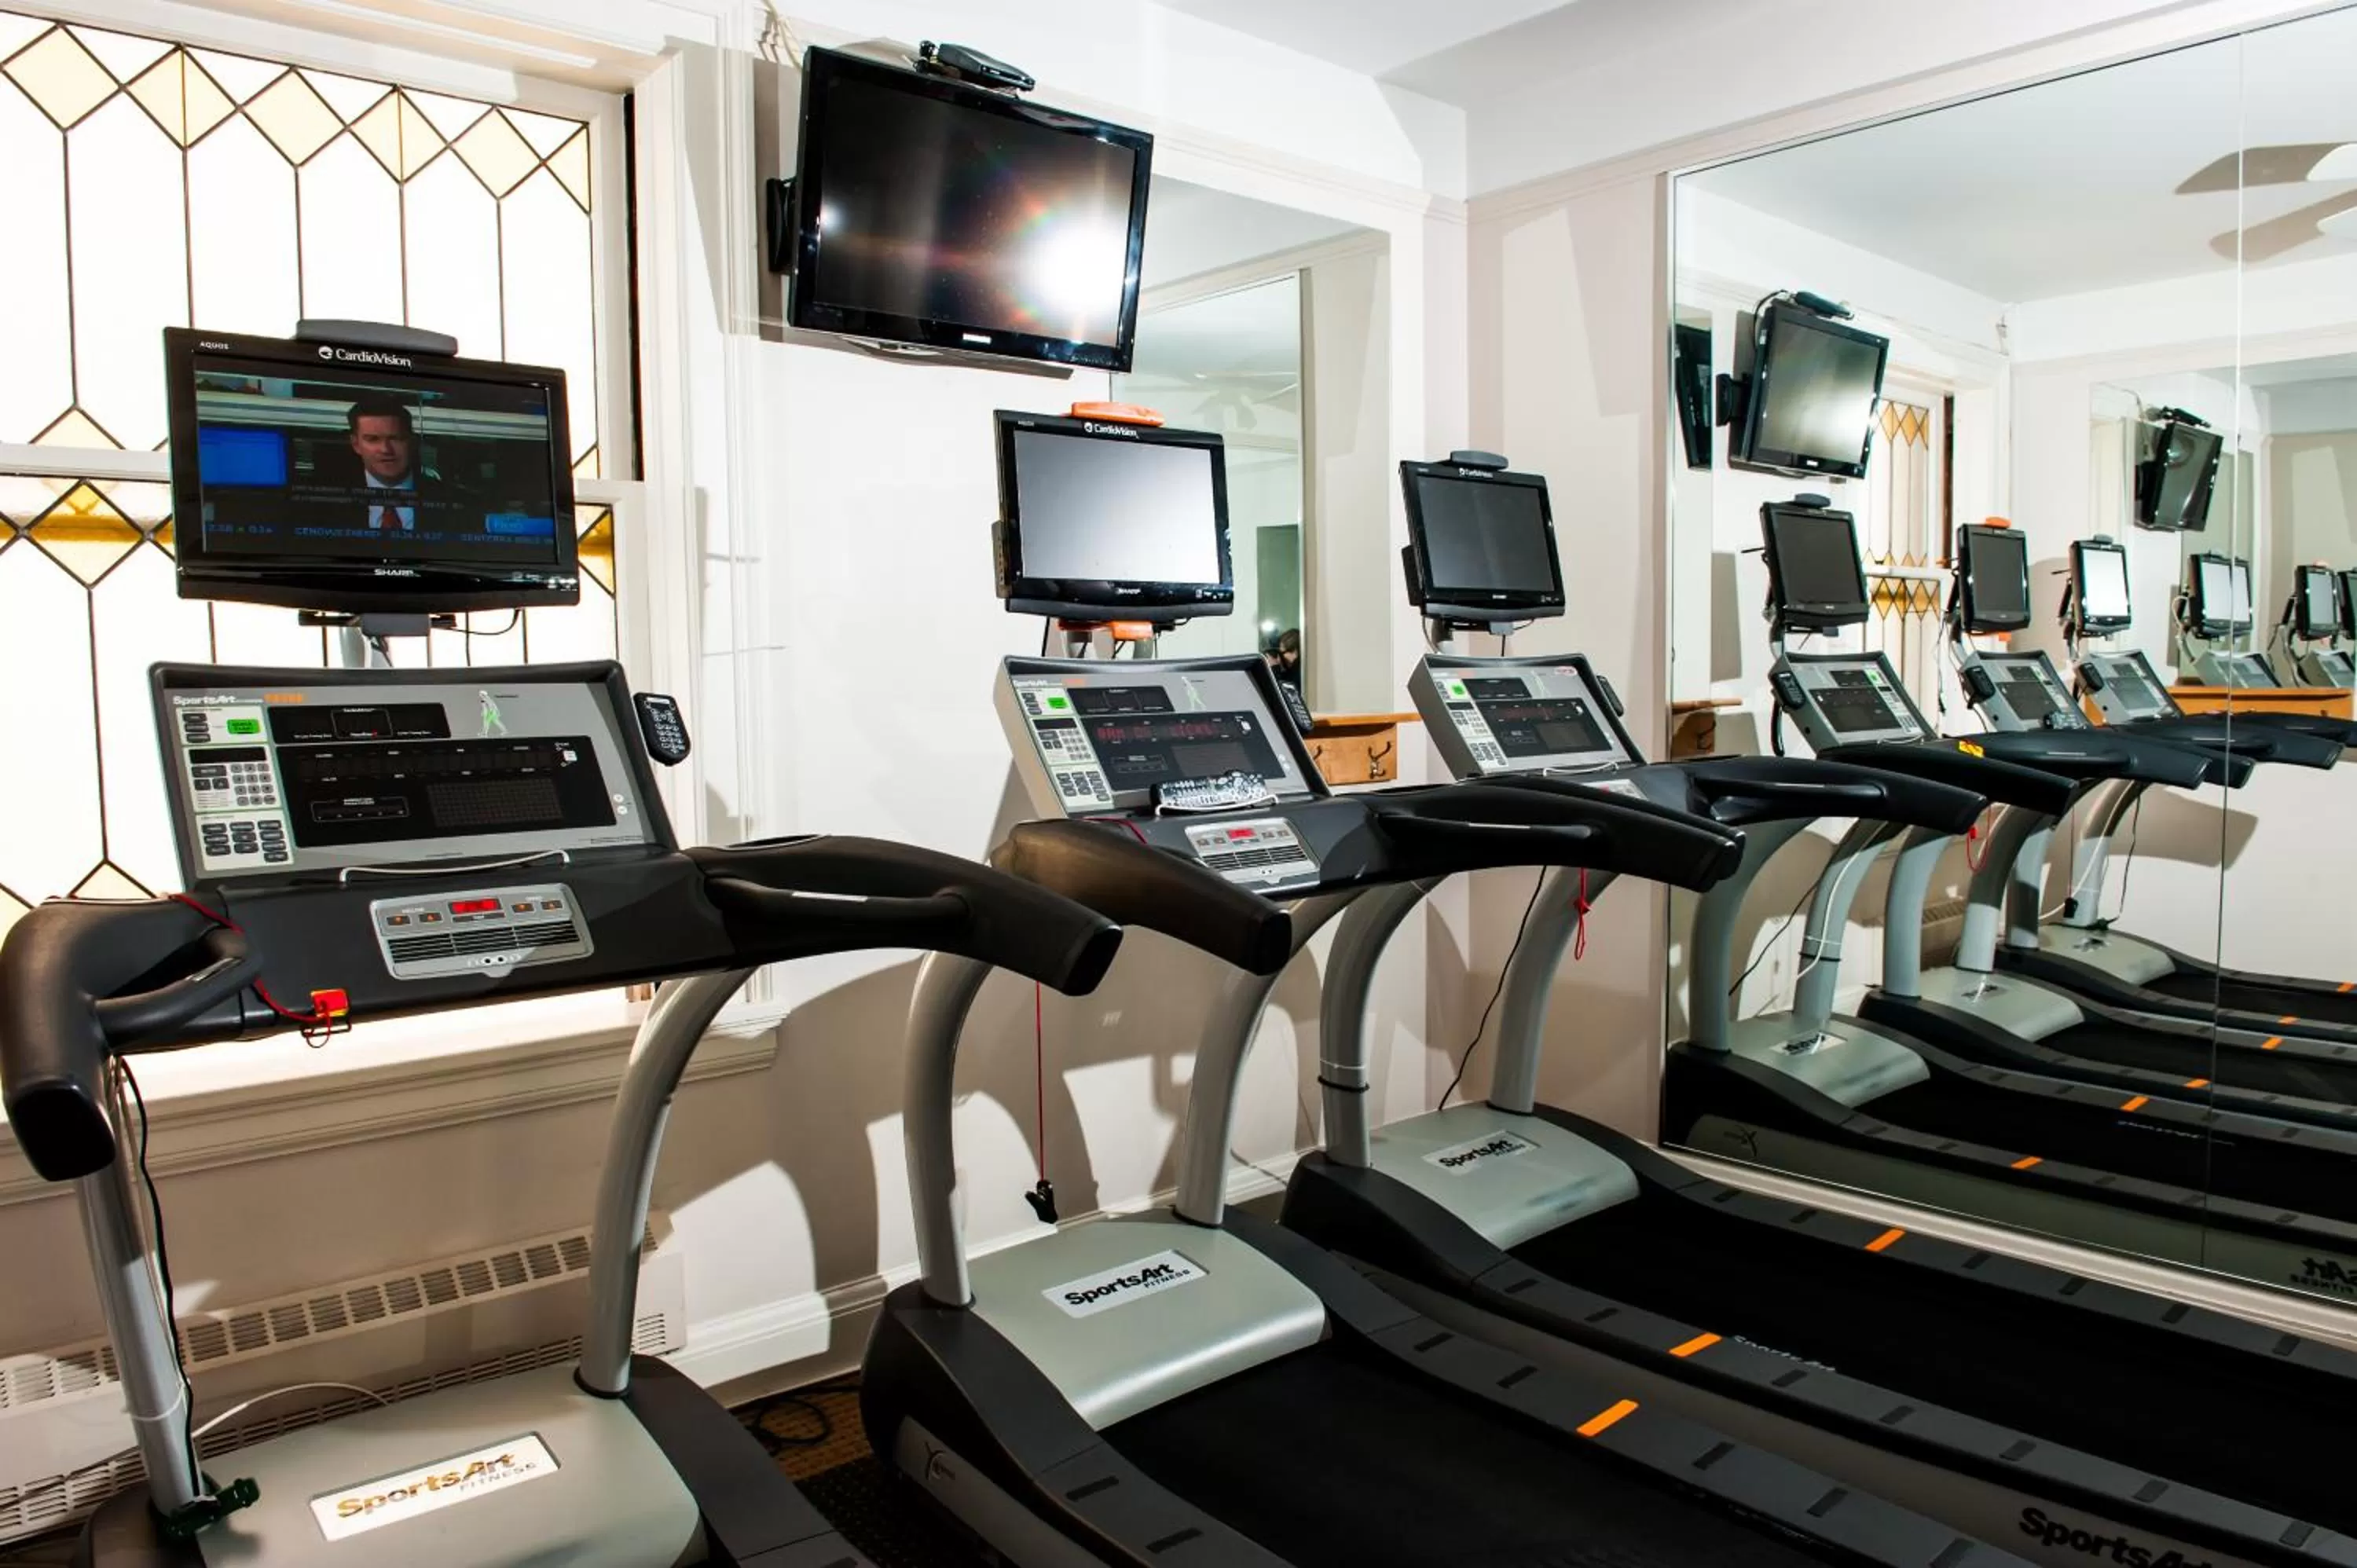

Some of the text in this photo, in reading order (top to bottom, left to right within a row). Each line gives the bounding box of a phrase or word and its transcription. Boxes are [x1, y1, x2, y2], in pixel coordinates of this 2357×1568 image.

[200, 340, 229, 350] AQUOS
[335, 348, 412, 368] CardioVision
[173, 695, 236, 706] SportsArt
[1439, 1139, 1514, 1167] SportsArt
[1065, 1263, 1175, 1306] SportsArt
[1144, 1269, 1191, 1289] FITNESS
[336, 1453, 515, 1519] SportsArt
[459, 1461, 538, 1492] FITNESS
